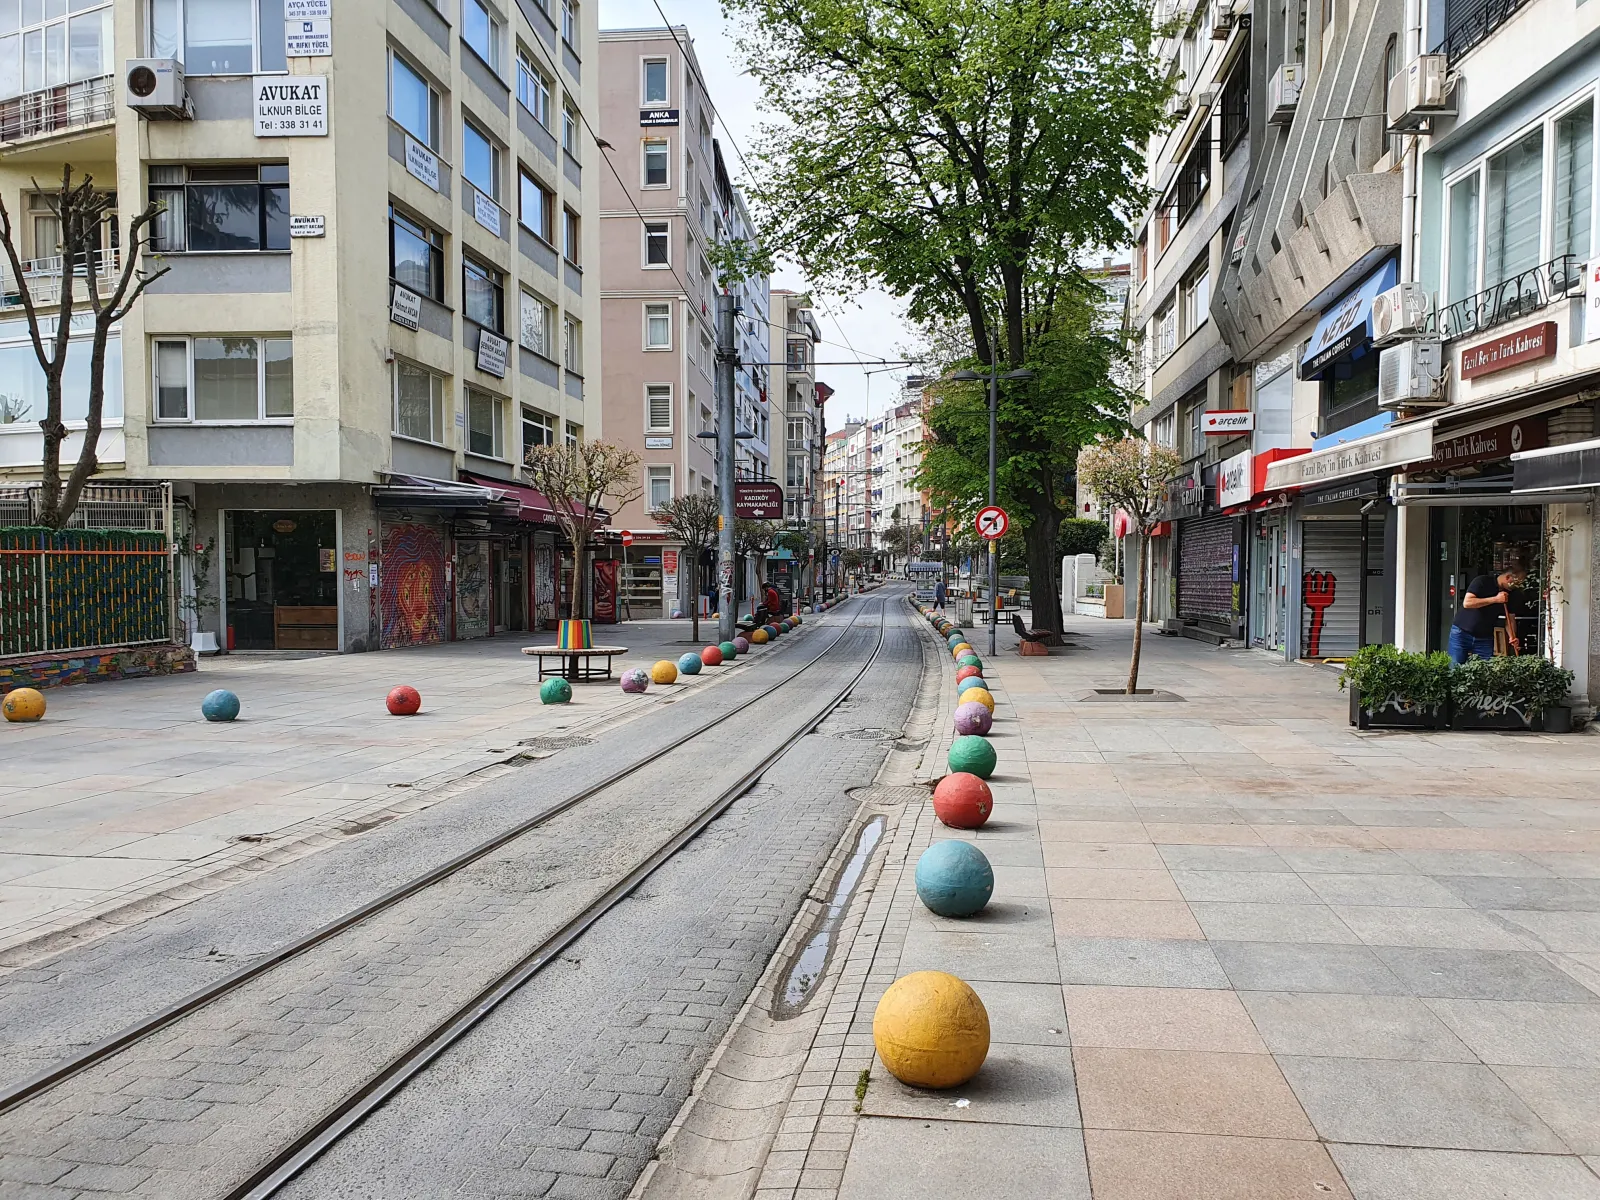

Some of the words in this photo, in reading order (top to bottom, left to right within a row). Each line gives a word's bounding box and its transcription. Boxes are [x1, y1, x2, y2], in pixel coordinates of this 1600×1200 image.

[288, 1, 304, 9] AYÇA
[259, 85, 320, 100] AVUKAT
[260, 104, 292, 116] İLKNUR
[295, 104, 322, 115] BİLGE
[260, 121, 272, 129] Tel
[280, 121, 296, 129] 338
[412, 144, 432, 164] AVUKAT
[1320, 351, 1332, 366] ITALIAN
[1332, 341, 1346, 356] COFFEE
[1499, 340, 1514, 360] Türk
[1218, 416, 1248, 427] arçelik
[1453, 438, 1469, 458] Türk
[1470, 433, 1497, 455] Kahvesi
[1302, 462, 1315, 476] Fazıl
[1338, 454, 1352, 470] Türk
[1355, 447, 1381, 466] Kahvesi
[1326, 493, 1338, 501] ITALIAN
[1340, 490, 1353, 498] COFFEE
